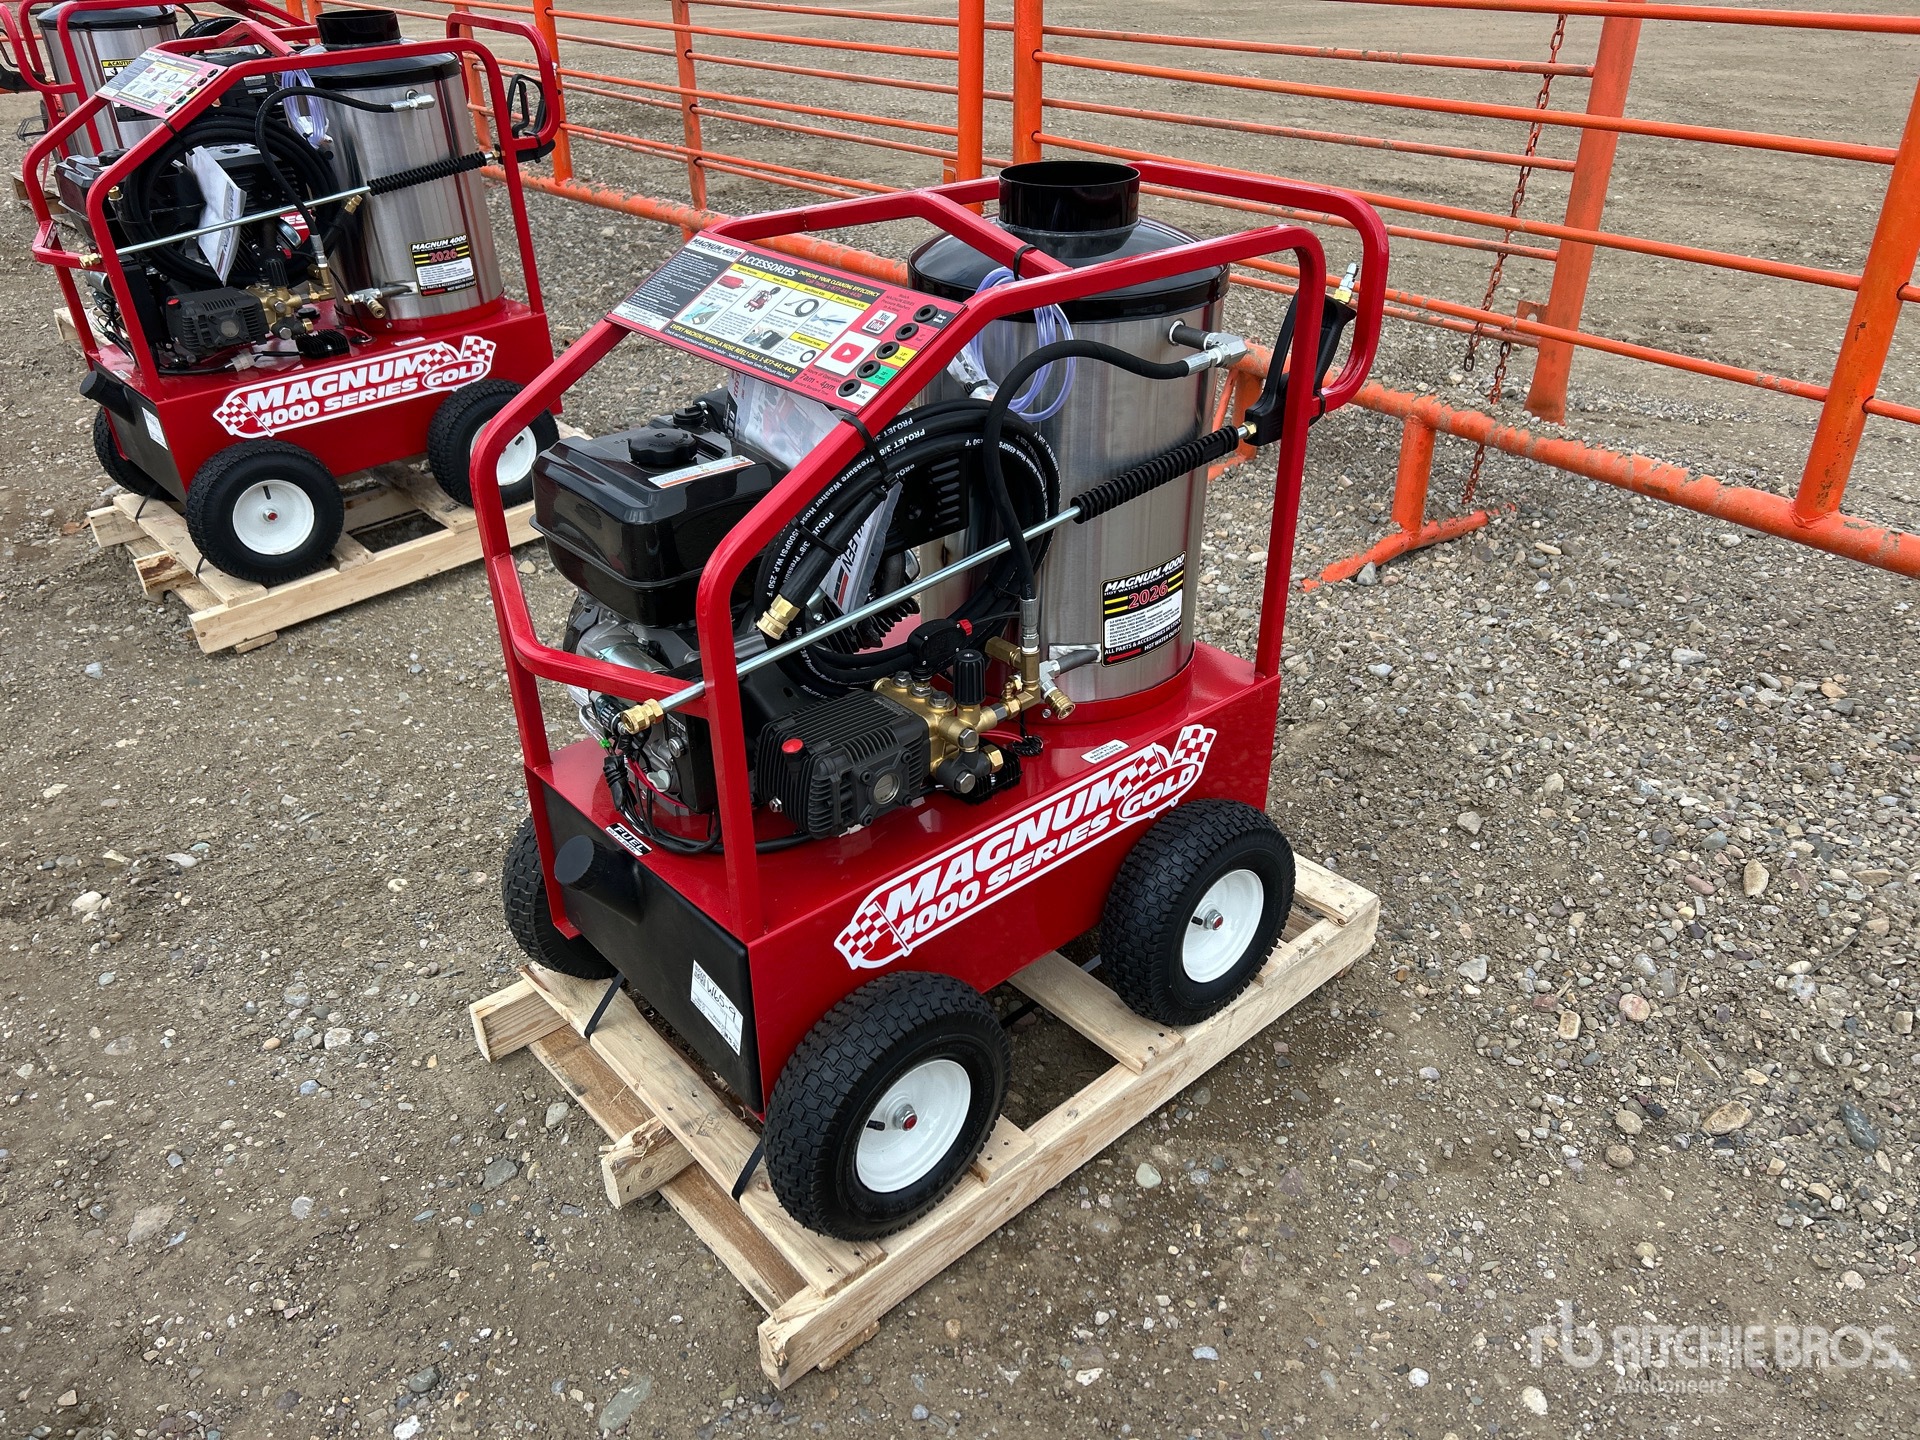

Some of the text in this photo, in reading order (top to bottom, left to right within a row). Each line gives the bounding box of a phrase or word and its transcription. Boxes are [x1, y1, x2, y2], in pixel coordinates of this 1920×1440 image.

[412, 239, 448, 250] MAGNUM
[450, 235, 466, 244] 4000
[692, 238, 724, 252] MAGNUM
[429, 248, 457, 263] 2026
[740, 255, 798, 277] ACCESSORIES
[819, 275, 830, 283] YOUR
[830, 278, 853, 290] CLEANING
[852, 284, 880, 297] EFFICIENCY
[868, 320, 884, 330] Tube
[880, 312, 890, 321] You
[670, 324, 685, 333] EVERY
[685, 327, 704, 340] MACHINE
[704, 334, 720, 346] NEEDS
[723, 343, 735, 352] HOSE
[735, 347, 748, 357] REEL!
[748, 352, 759, 360] CALL
[427, 362, 483, 386] GOLD
[739, 356, 753, 365] Magnum
[753, 361, 763, 369] Series
[764, 365, 777, 374] Pressure
[777, 370, 790, 379] Washers
[823, 373, 840, 383] Operation
[247, 353, 426, 412] MAGNUM
[800, 373, 836, 391] 7am 4pm
[257, 378, 418, 427] 4000 SERIES
[884, 418, 914, 438] PROJET
[894, 428, 926, 449] PROJET
[999, 441, 1016, 454] 4500PS
[1016, 450, 1026, 461] Hose
[841, 455, 875, 482] Pressure
[895, 464, 915, 479] PROJ
[816, 482, 842, 508] Washer
[811, 512, 834, 536] PROJE
[772, 558, 785, 574] W.P.
[1105, 554, 1185, 592] MAGNUM 4000
[768, 575, 777, 589] 250
[1139, 574, 1164, 586] PRESSURE
[1128, 580, 1168, 609] 2026
[1116, 642, 1132, 652] PARTS
[1137, 628, 1165, 646] ACCESSORIES
[1155, 636, 1169, 646] WATER
[1169, 625, 1182, 638] OUTLET
[1122, 765, 1196, 818] GOLD
[614, 827, 643, 852] FUEL
[885, 764, 1131, 920] MAGNUM
[893, 808, 1113, 945] 4000 SERIES
